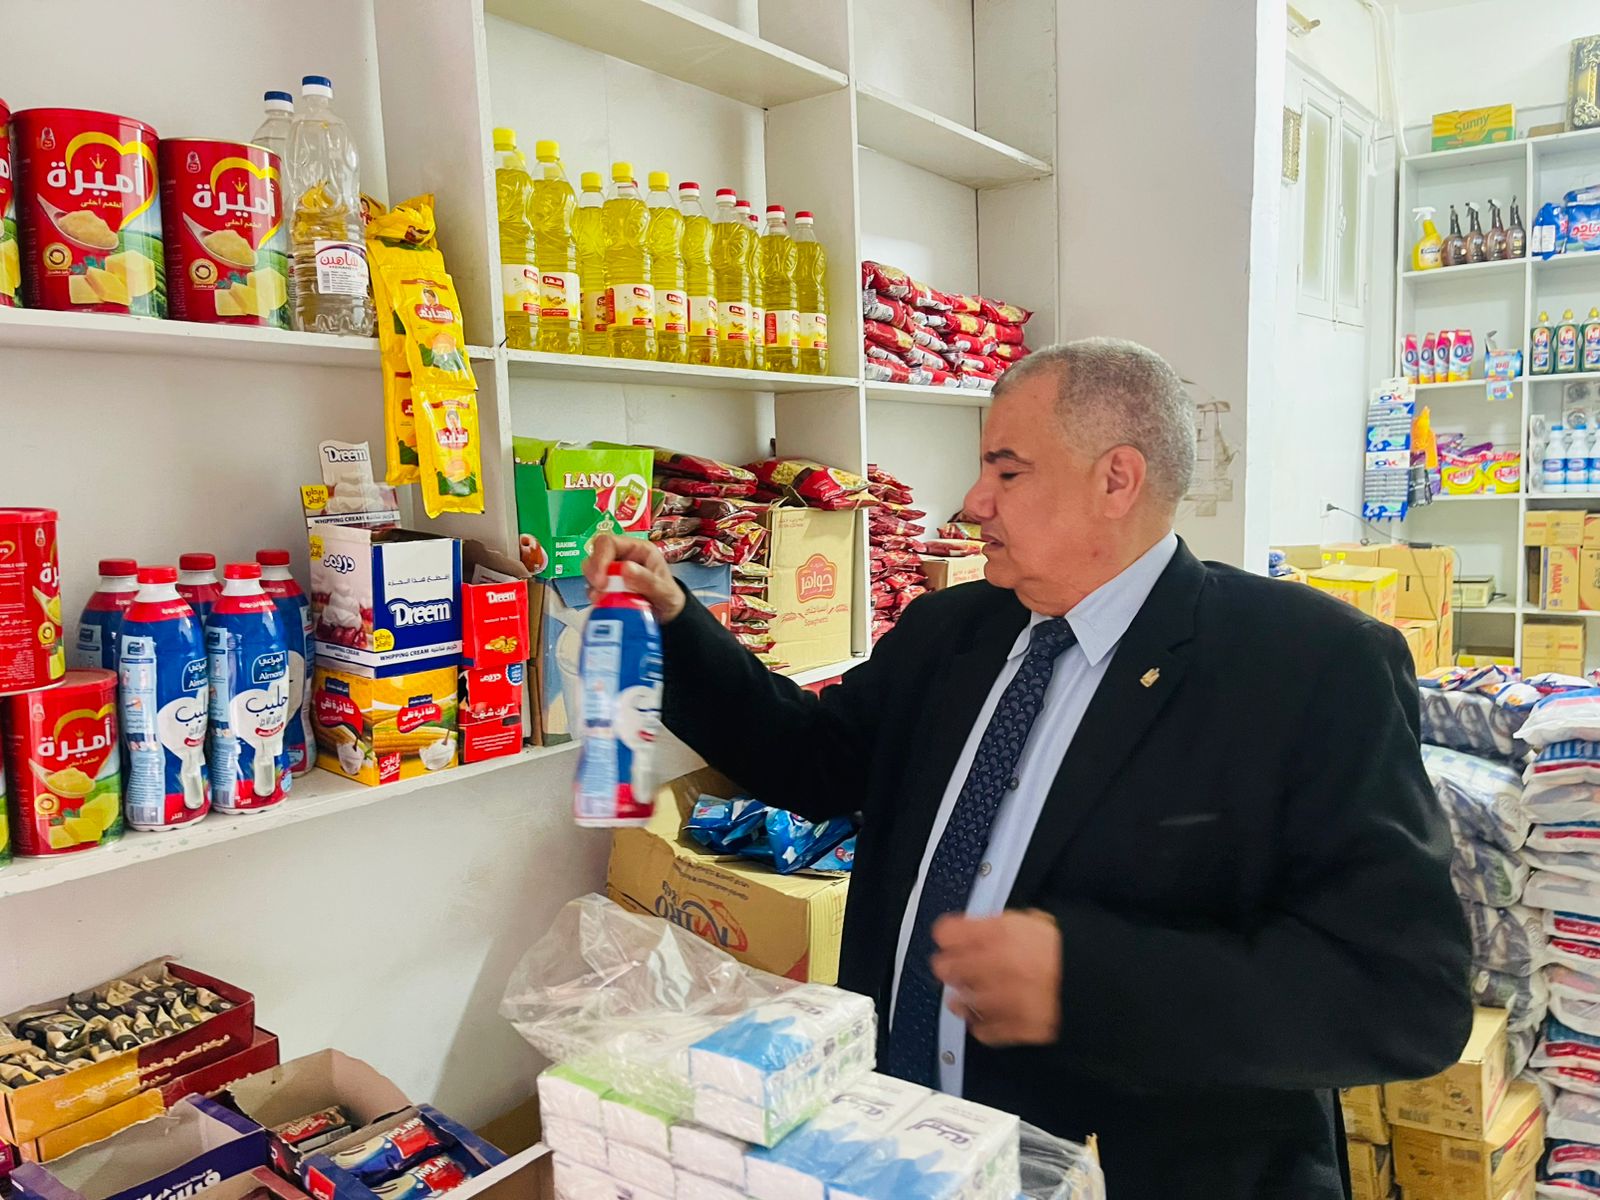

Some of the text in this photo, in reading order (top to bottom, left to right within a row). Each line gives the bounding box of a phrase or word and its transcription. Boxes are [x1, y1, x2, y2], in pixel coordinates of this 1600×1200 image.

[1455, 113, 1489, 134] Sunny
[47, 159, 144, 197] أميرة
[192, 183, 277, 218] أميرة
[324, 447, 369, 463] Dreem
[564, 473, 615, 489] LANO
[324, 555, 355, 574] دريم
[486, 590, 516, 604] Dreem
[390, 603, 451, 627] Dreem
[380, 653, 409, 661] WHIPPING
[37, 717, 112, 761] أميرة
